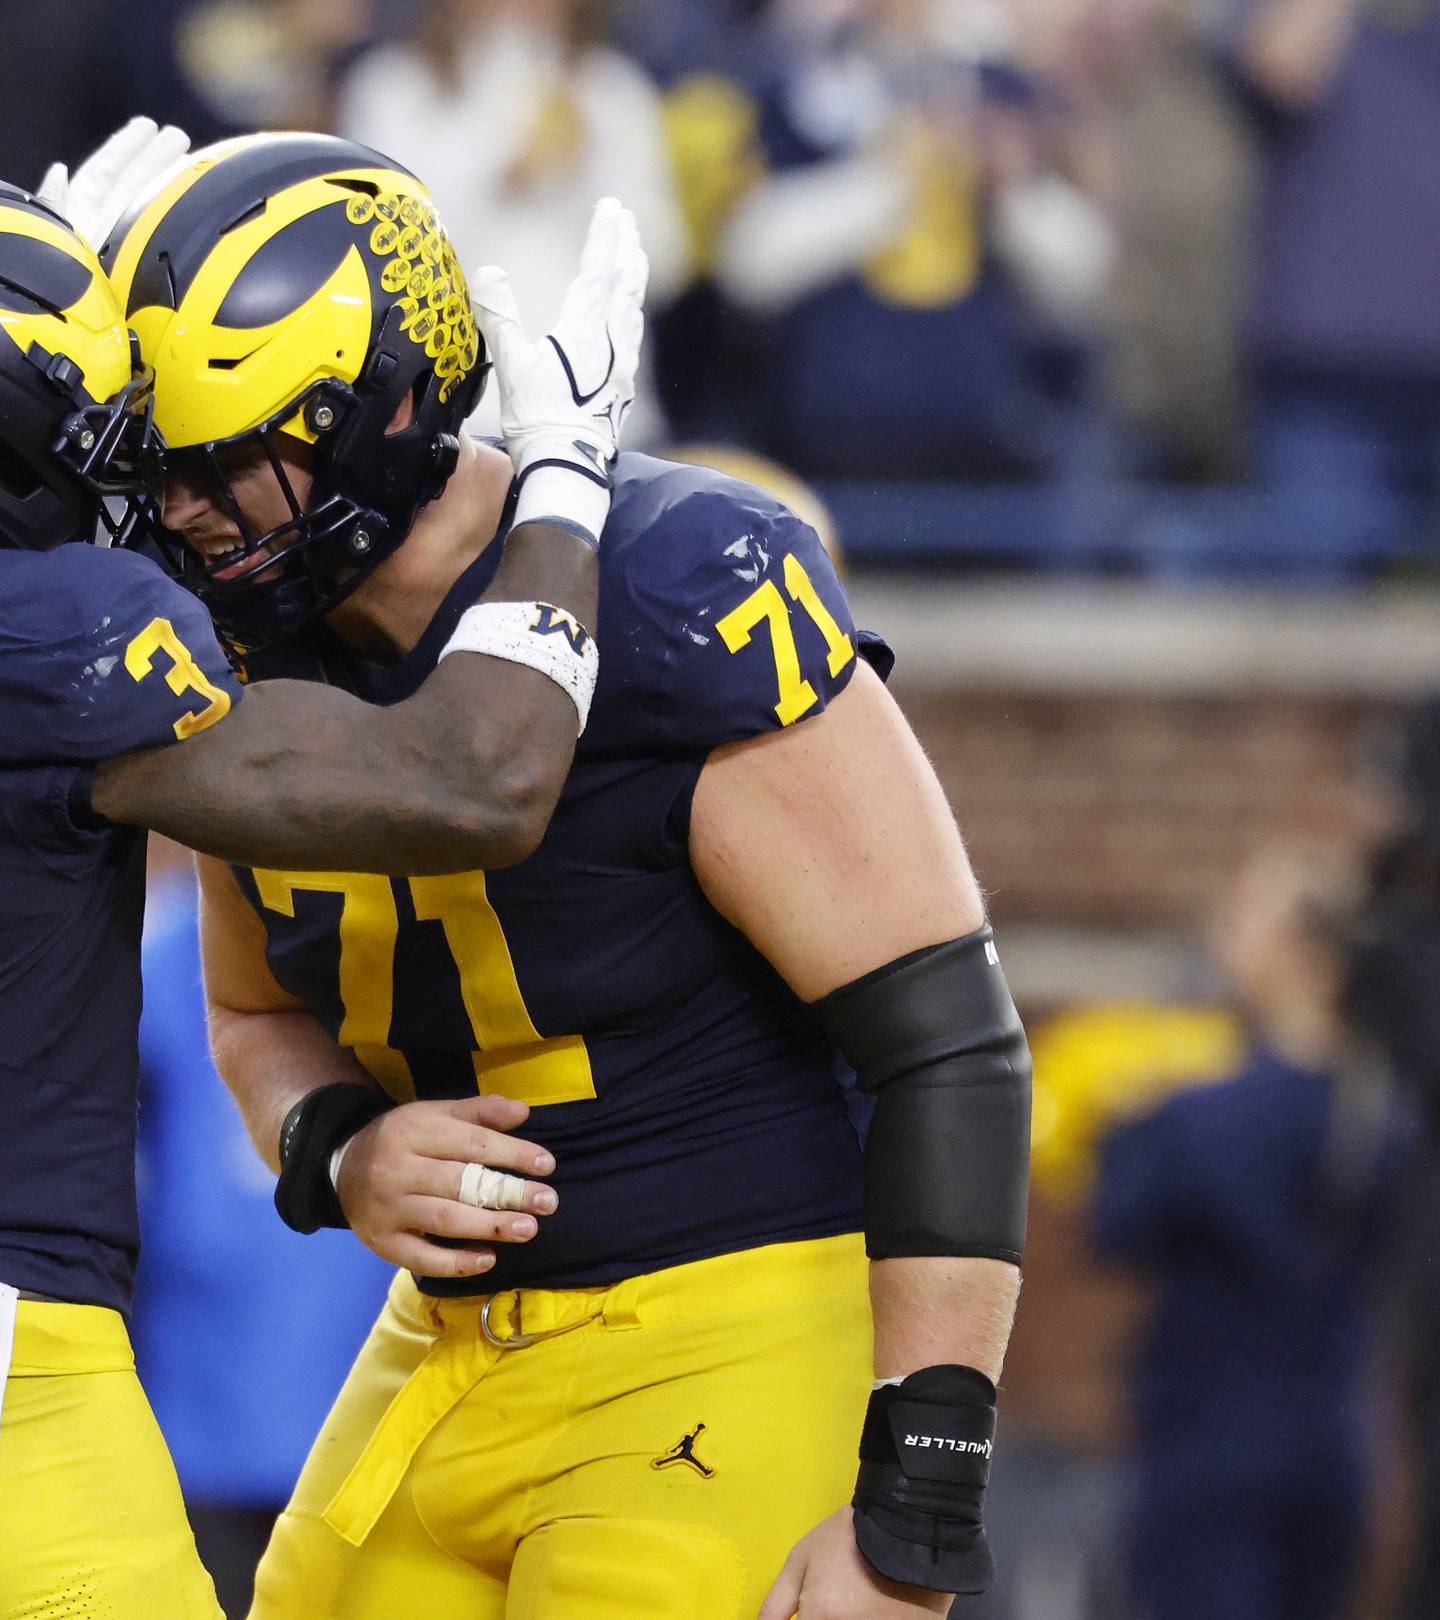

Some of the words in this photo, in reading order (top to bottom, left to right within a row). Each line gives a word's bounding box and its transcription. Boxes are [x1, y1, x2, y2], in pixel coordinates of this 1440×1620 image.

[124, 617, 232, 741] 3
[527, 602, 591, 658] M
[715, 553, 855, 727] 71
[252, 868, 598, 1107] 71
[904, 1434, 987, 1454] MUELLER
